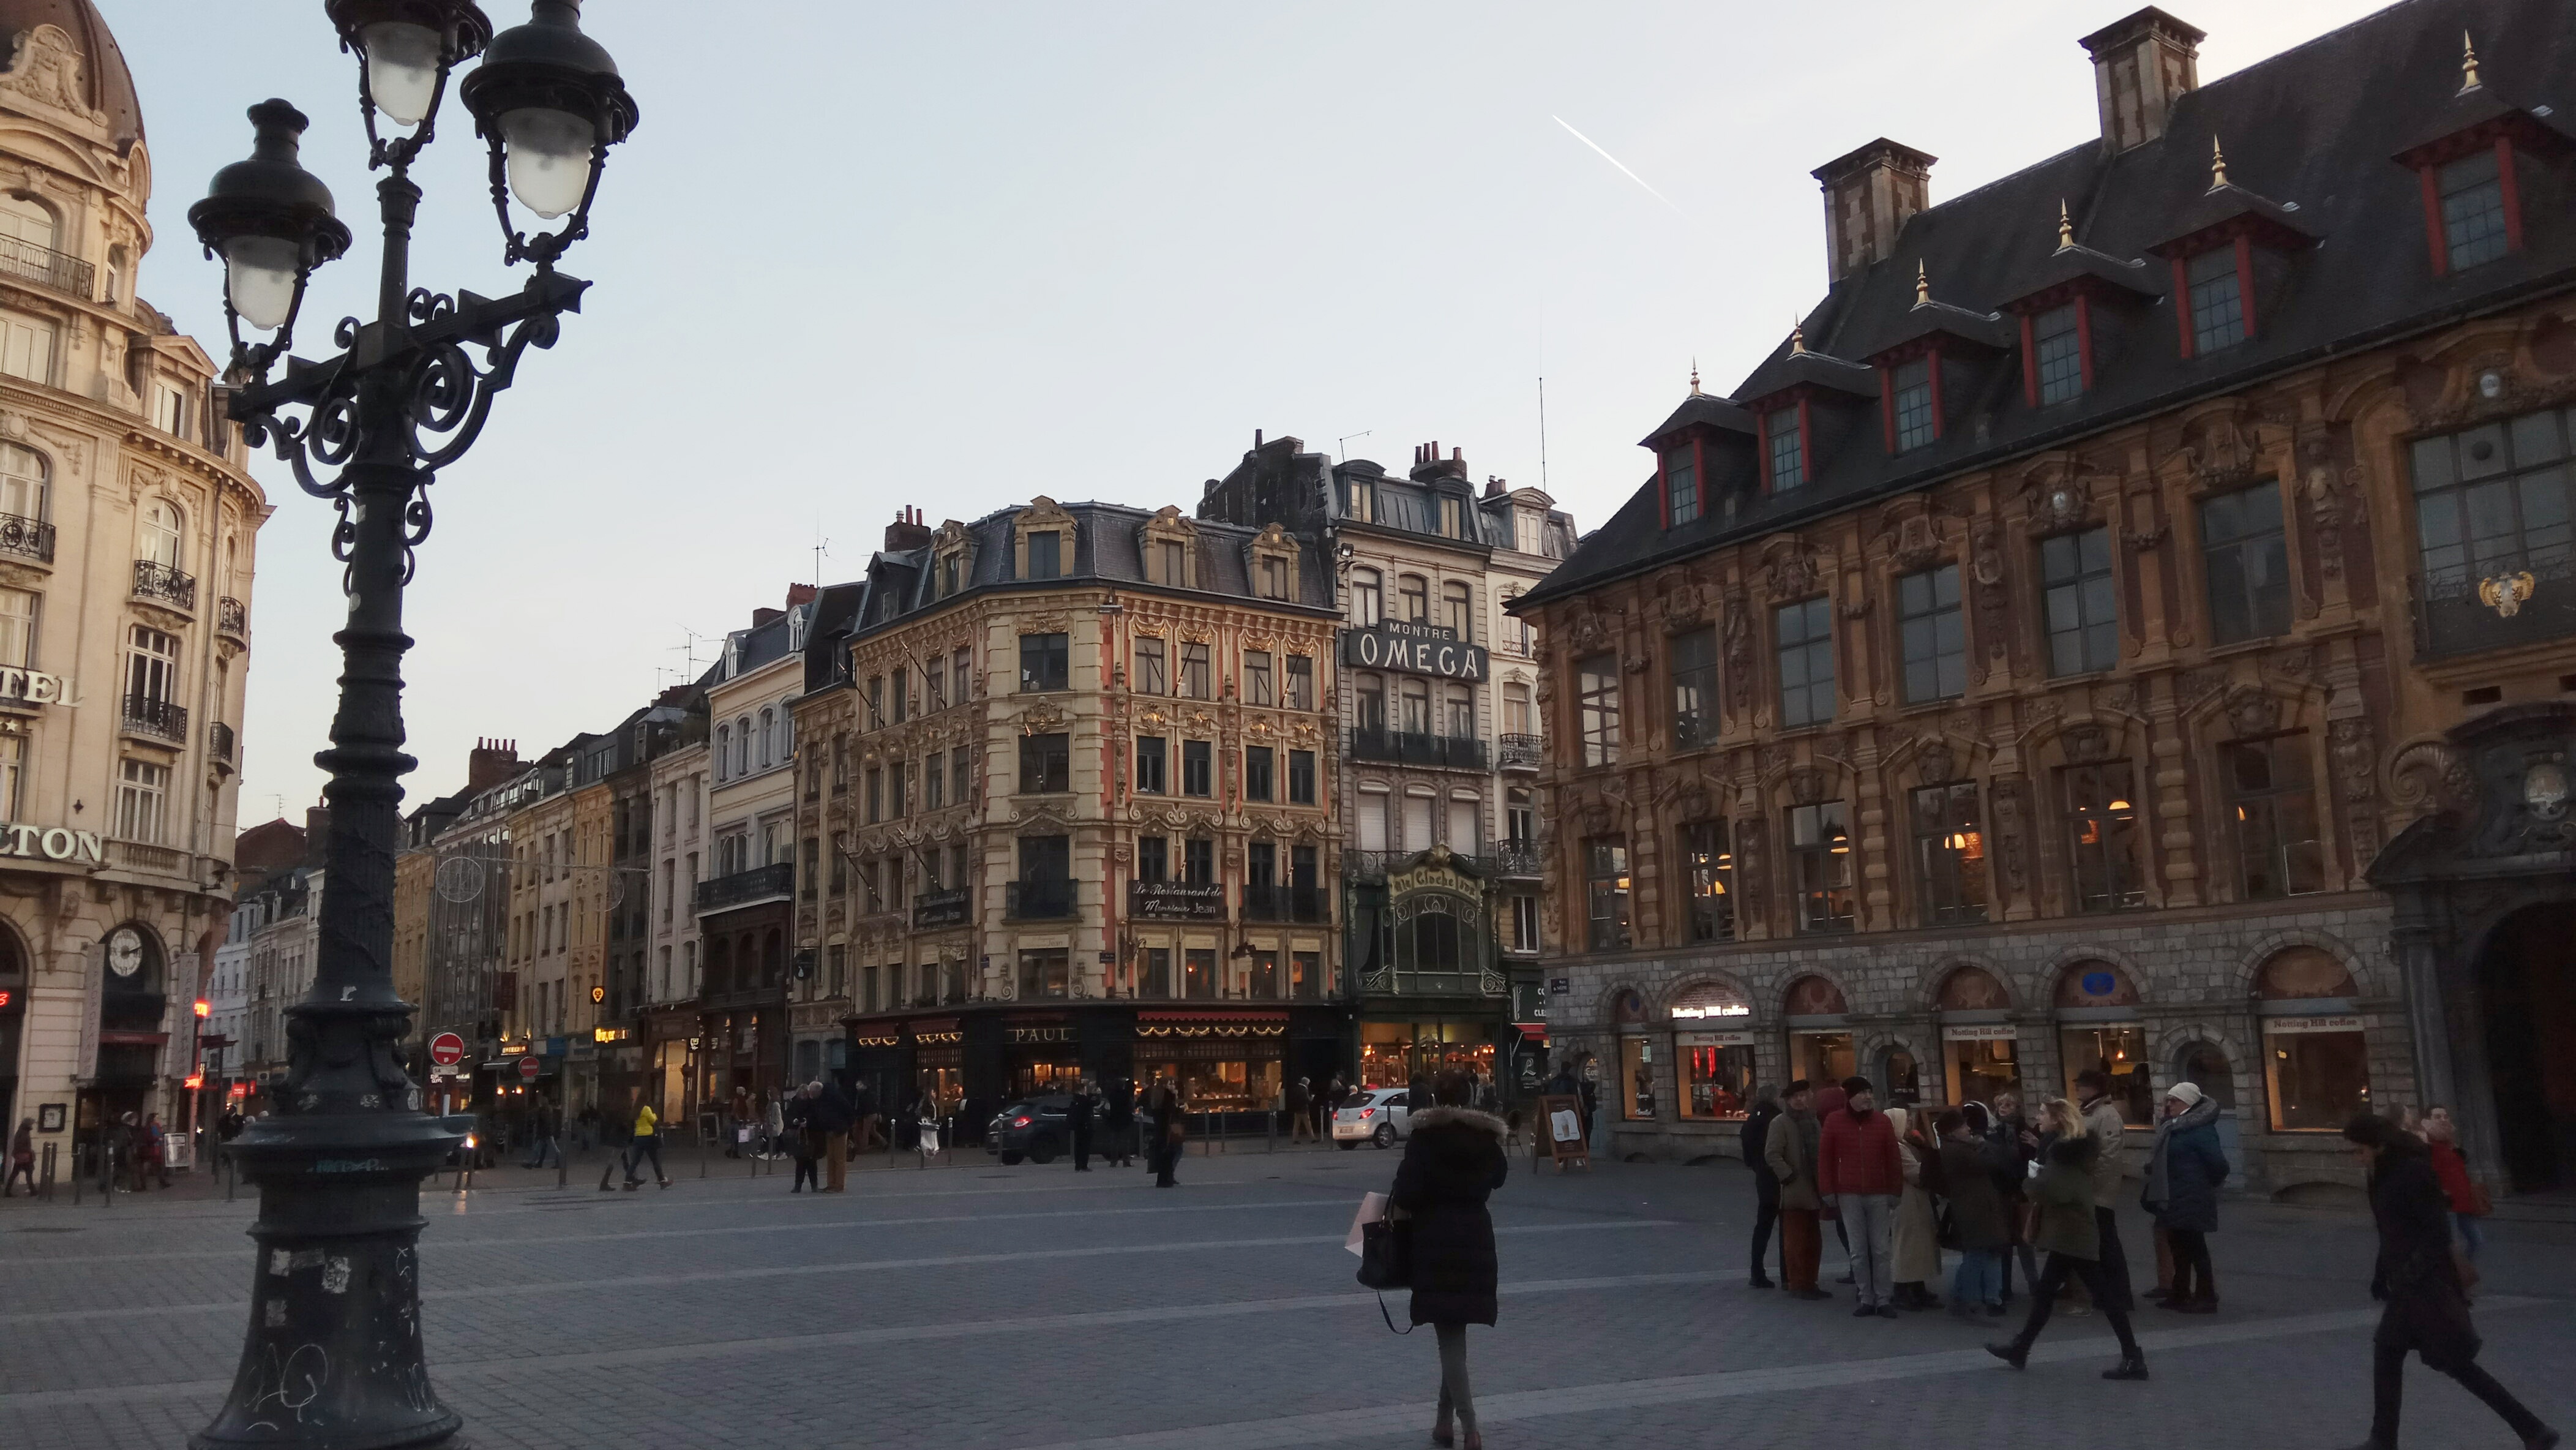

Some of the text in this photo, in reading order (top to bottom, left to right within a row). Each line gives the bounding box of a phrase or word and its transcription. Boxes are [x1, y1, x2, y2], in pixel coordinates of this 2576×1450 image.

[1390, 622, 1450, 640] MONTRE
[1360, 633, 1478, 678] OMEGA
[1133, 882, 1224, 897] Le Restaurant de
[1193, 902, 1216, 914] Jean
[1672, 1005, 1750, 1019] Notting Hill coffee
[2274, 1018, 2357, 1029] Notting Hill coffee
[1016, 1028, 1069, 1042] PAUL
